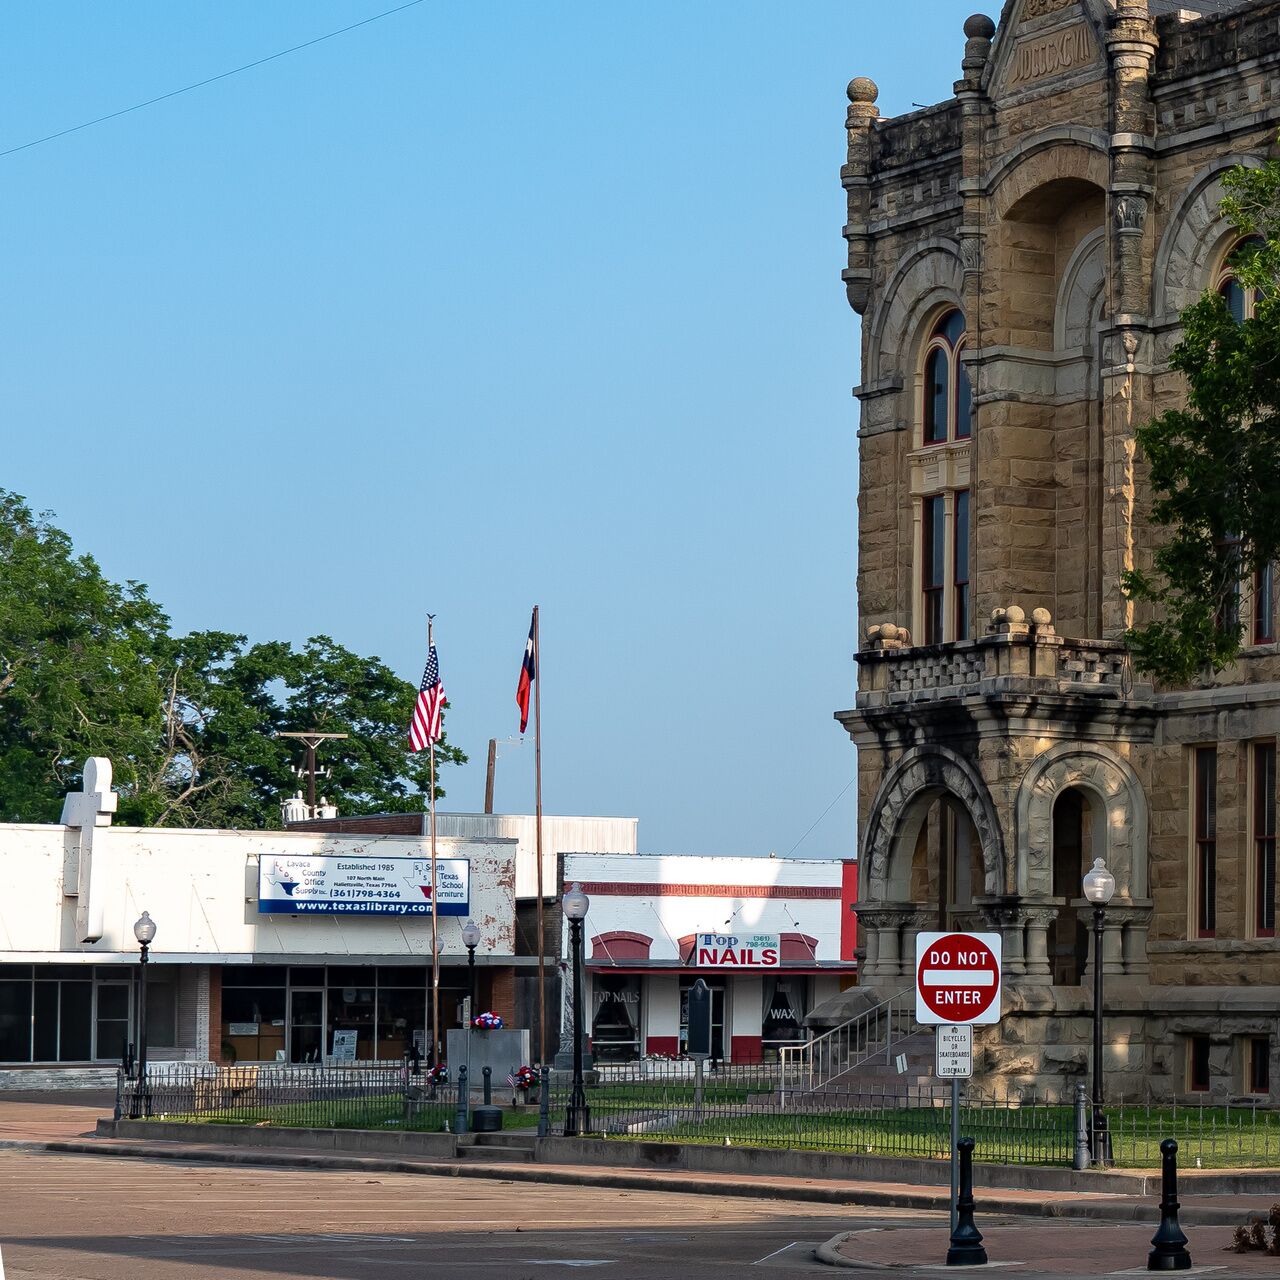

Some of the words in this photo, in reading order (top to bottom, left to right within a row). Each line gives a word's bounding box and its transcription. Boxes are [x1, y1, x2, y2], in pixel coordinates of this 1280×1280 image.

[337, 863, 376, 871] Established
[302, 869, 327, 877] County
[440, 872, 459, 880] Texas
[304, 878, 325, 886] Office
[442, 881, 464, 889] School
[295, 887, 319, 896] Supply
[329, 889, 401, 898] (361)798-4364
[700, 933, 739, 948] Top
[699, 948, 778, 965] NAILS
[930, 951, 951, 966] DO
[957, 951, 988, 966] NOT
[593, 991, 611, 1003] TOP
[612, 991, 640, 1003] NAILS
[935, 990, 981, 1005] ENTER
[770, 1008, 796, 1019] WAX
